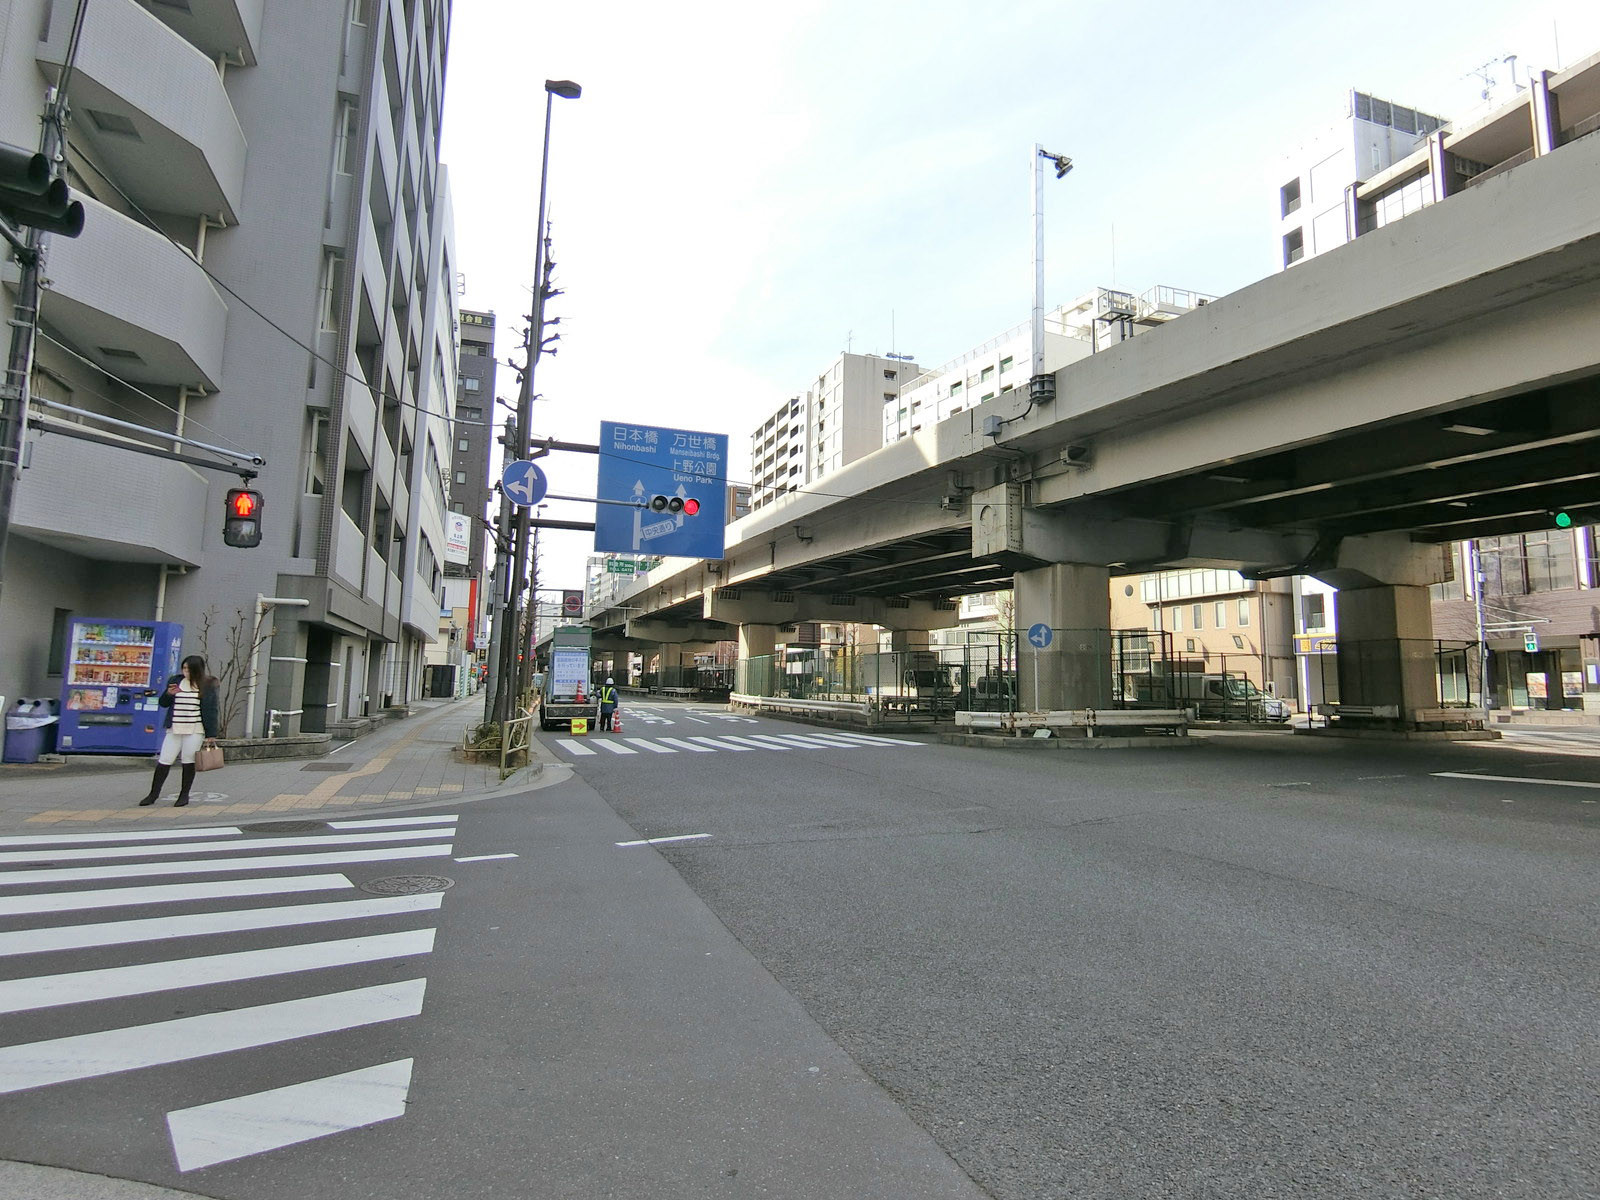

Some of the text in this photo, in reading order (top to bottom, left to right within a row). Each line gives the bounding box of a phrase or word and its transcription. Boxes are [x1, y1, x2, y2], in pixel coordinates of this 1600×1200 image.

[613, 427, 659, 445] 日本橋
[673, 433, 717, 451] 万世橋
[613, 441, 657, 454] Nihonbashi
[671, 459, 717, 476] 上野公園
[673, 474, 713, 485] Ueno Park
[644, 522, 672, 536] 中央通り
